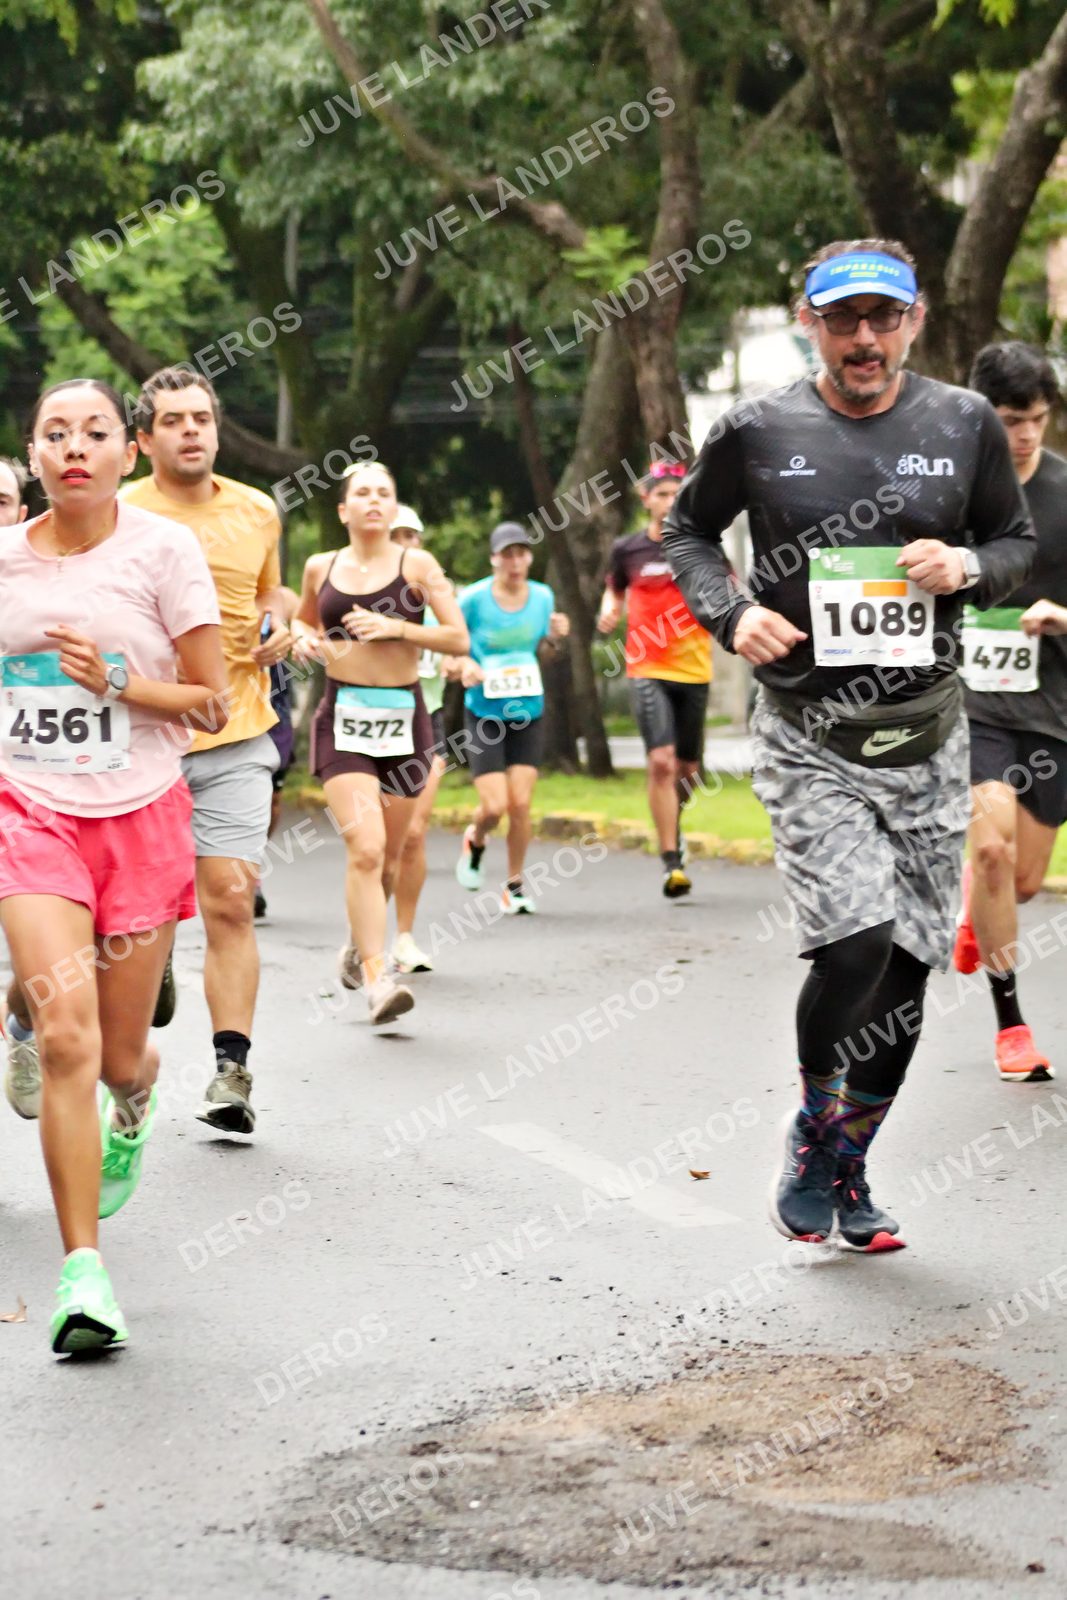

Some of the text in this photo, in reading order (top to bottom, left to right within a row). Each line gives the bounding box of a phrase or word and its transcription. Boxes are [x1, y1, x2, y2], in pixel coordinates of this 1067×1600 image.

[823, 601, 926, 637] 1089
[490, 674, 533, 692] 6321
[9, 706, 112, 744] 4561
[341, 718, 405, 739] 5272
